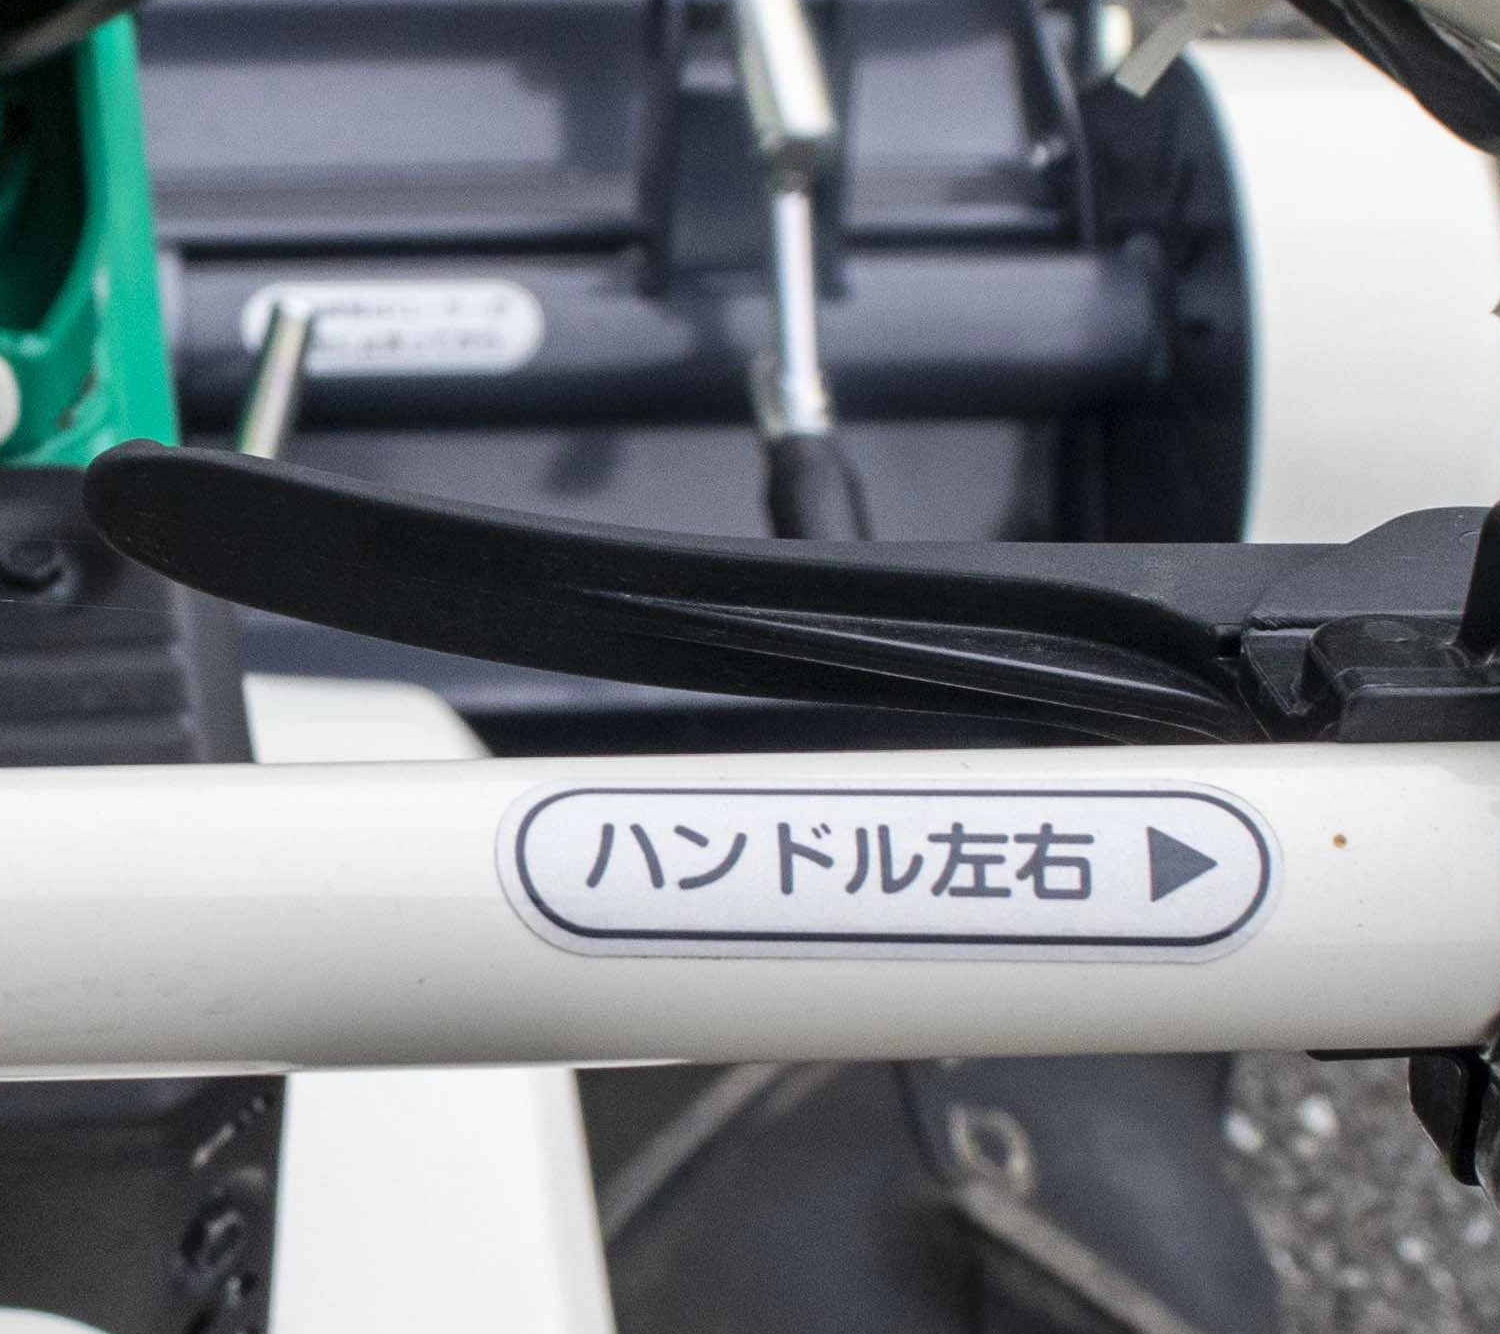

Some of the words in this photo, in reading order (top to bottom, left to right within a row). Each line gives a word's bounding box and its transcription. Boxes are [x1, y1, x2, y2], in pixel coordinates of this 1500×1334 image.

[585, 821, 1095, 900] ハンドル左右
